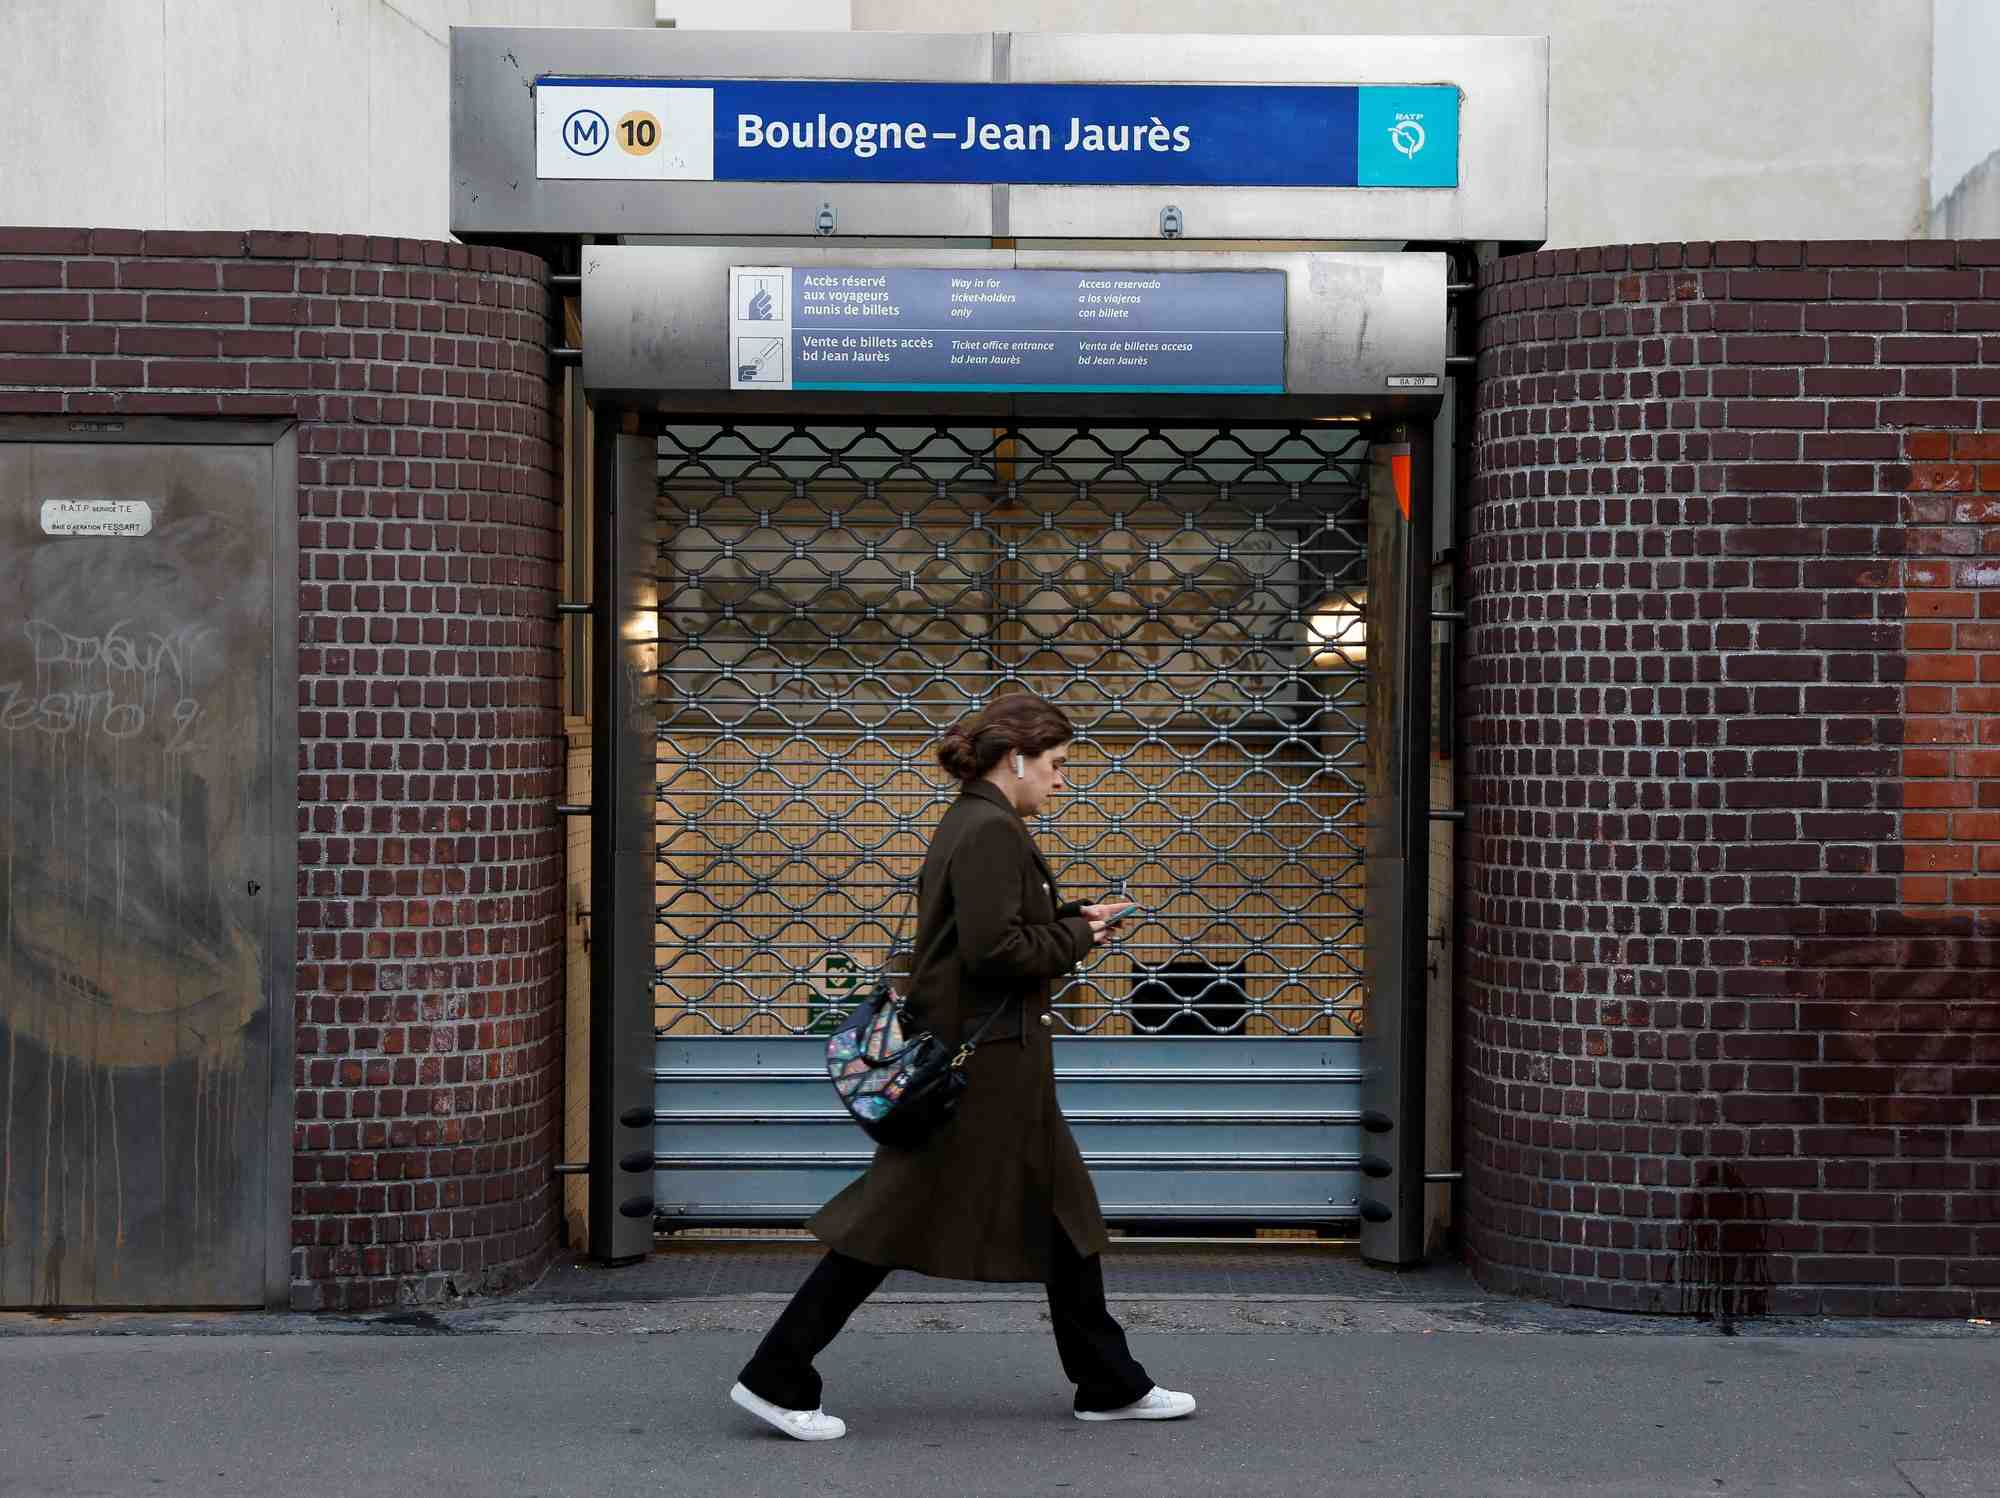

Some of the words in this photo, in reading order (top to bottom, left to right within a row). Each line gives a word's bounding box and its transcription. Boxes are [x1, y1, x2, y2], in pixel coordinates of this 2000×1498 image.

[1395, 112, 1424, 120] RATP
[620, 119, 656, 148] 10
[1065, 116, 1192, 153] Jaurès
[804, 275, 839, 287] Accès
[842, 275, 886, 287] réservé
[951, 278, 972, 290] Way
[975, 278, 984, 288] in
[985, 278, 1001, 291] for
[1079, 279, 1111, 289] Acceso
[1114, 279, 1161, 289] reservado
[803, 291, 826, 301] aux
[828, 291, 889, 304] voyageurs
[951, 292, 1016, 303] ticket-holders
[1078, 295, 1085, 303] a
[1088, 293, 1102, 303] los
[1104, 294, 1141, 305] viajeros
[803, 305, 841, 316] munis
[844, 304, 859, 316] de
[862, 304, 901, 317] billets
[951, 307, 973, 319] only
[1078, 309, 1096, 318] con
[1098, 308, 1129, 318] billete
[802, 336, 838, 348] Vente
[841, 335, 857, 348] de
[860, 335, 898, 348] billets
[900, 336, 934, 349] accès
[951, 340, 980, 351] Ticket
[982, 340, 1009, 352] office
[1011, 342, 1055, 351] entrance
[1079, 341, 1108, 351] Venta
[1110, 341, 1122, 351] de
[1124, 341, 1159, 352] billetes
[1161, 343, 1193, 352] acceso
[802, 350, 818, 362] bd
[822, 351, 849, 362] Jean
[852, 351, 890, 362] Jaurès
[950, 354, 964, 365] bd
[965, 355, 988, 366] Jean
[990, 355, 1022, 365] Jaurès
[1078, 355, 1091, 365] bd
[1092, 355, 1116, 366] Jean
[1117, 355, 1149, 366] Jaurès
[103, 523, 140, 531] FESSART
